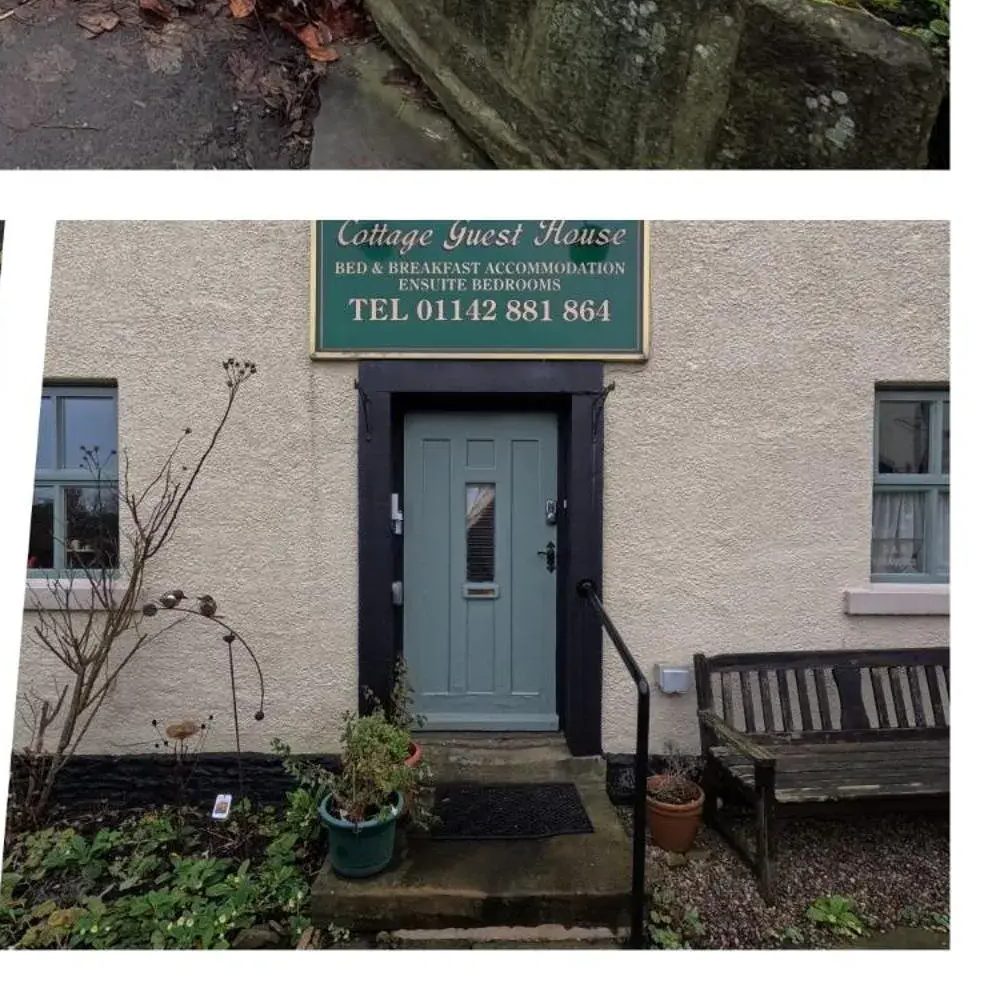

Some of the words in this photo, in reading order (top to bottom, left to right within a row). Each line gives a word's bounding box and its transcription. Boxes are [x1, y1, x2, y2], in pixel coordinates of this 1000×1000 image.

[337, 220, 433, 255] Cottage
[444, 220, 524, 250] Guest
[534, 220, 627, 247] House
[335, 262, 367, 274] BED
[371, 262, 383, 274] &
[388, 261, 480, 275] BREAKFAST
[484, 261, 625, 275] ACCOMMODATION
[399, 278, 467, 292] ENSUITE
[472, 278, 561, 292] BEDROOMS
[349, 298, 409, 322] TEL
[416, 298, 497, 322] 01142
[505, 298, 553, 322] 881
[563, 298, 611, 322] 864
